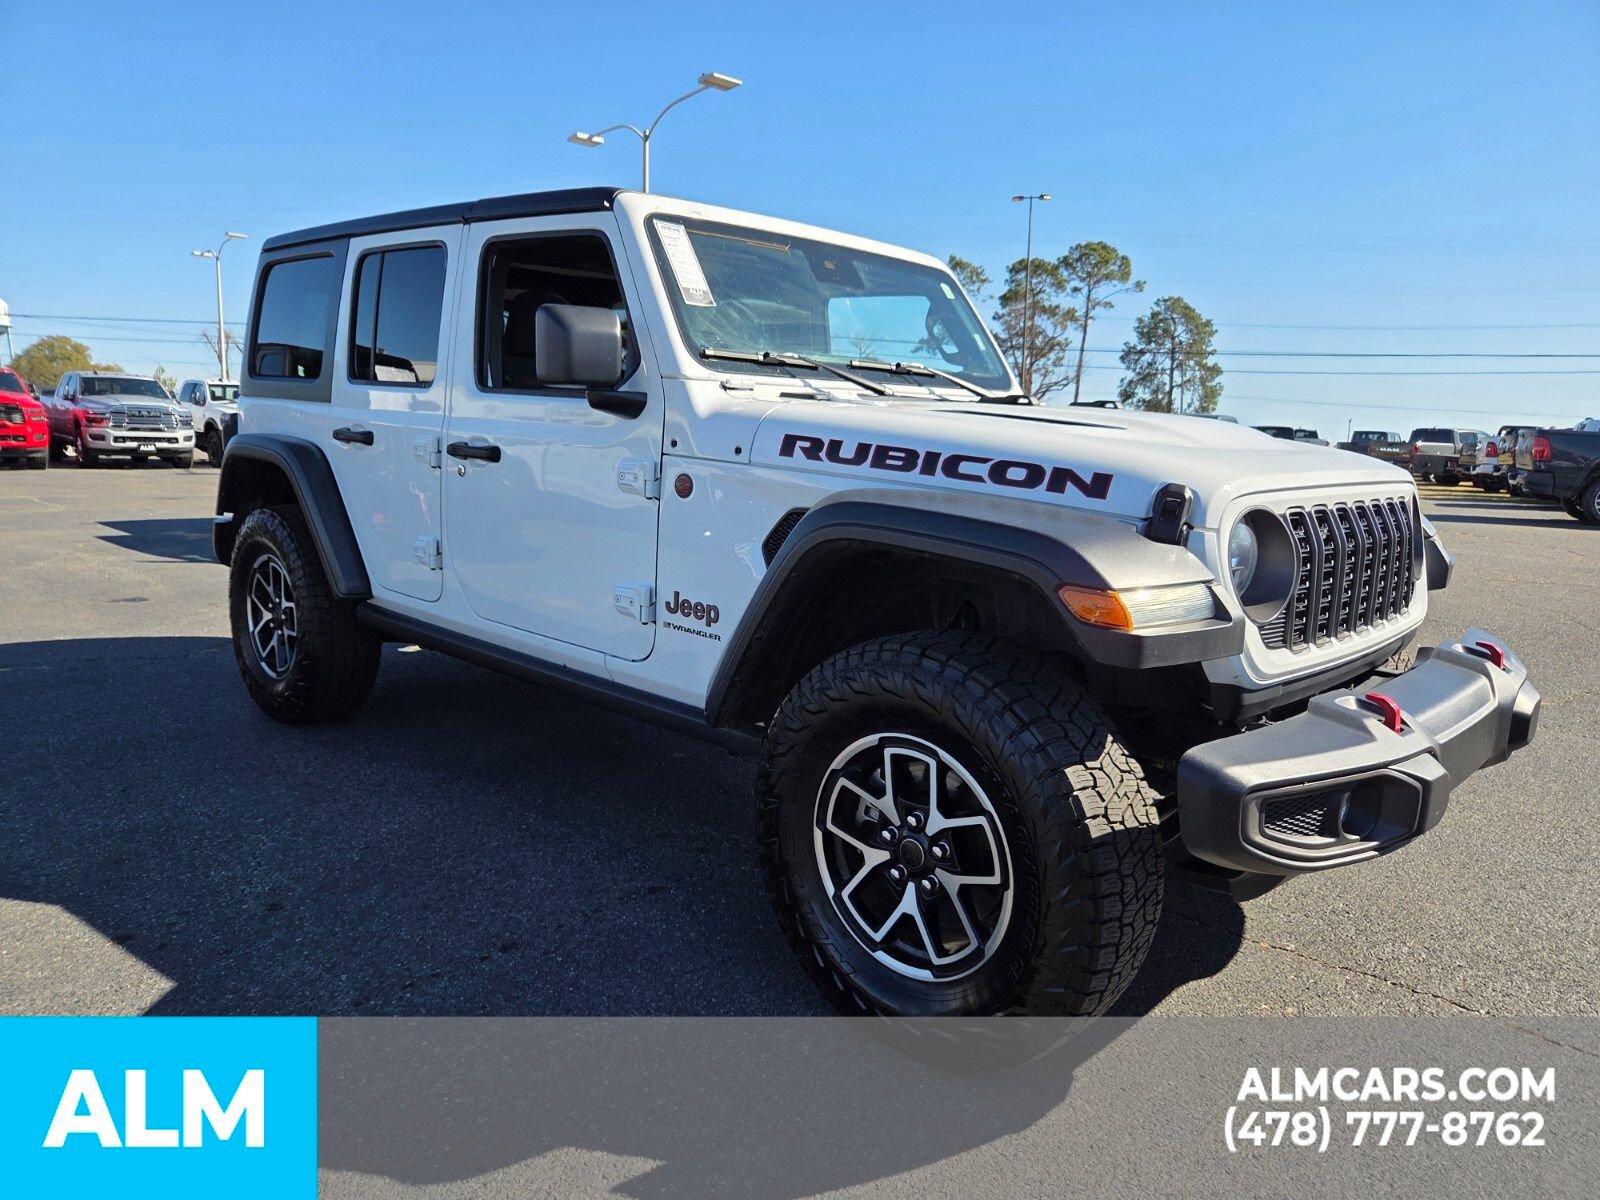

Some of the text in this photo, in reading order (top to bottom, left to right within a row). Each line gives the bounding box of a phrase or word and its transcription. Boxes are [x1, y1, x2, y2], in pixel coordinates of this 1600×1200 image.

[778, 433, 1114, 500] RUBICON
[664, 590, 720, 628] Jeep
[671, 622, 721, 642] WRANGLER
